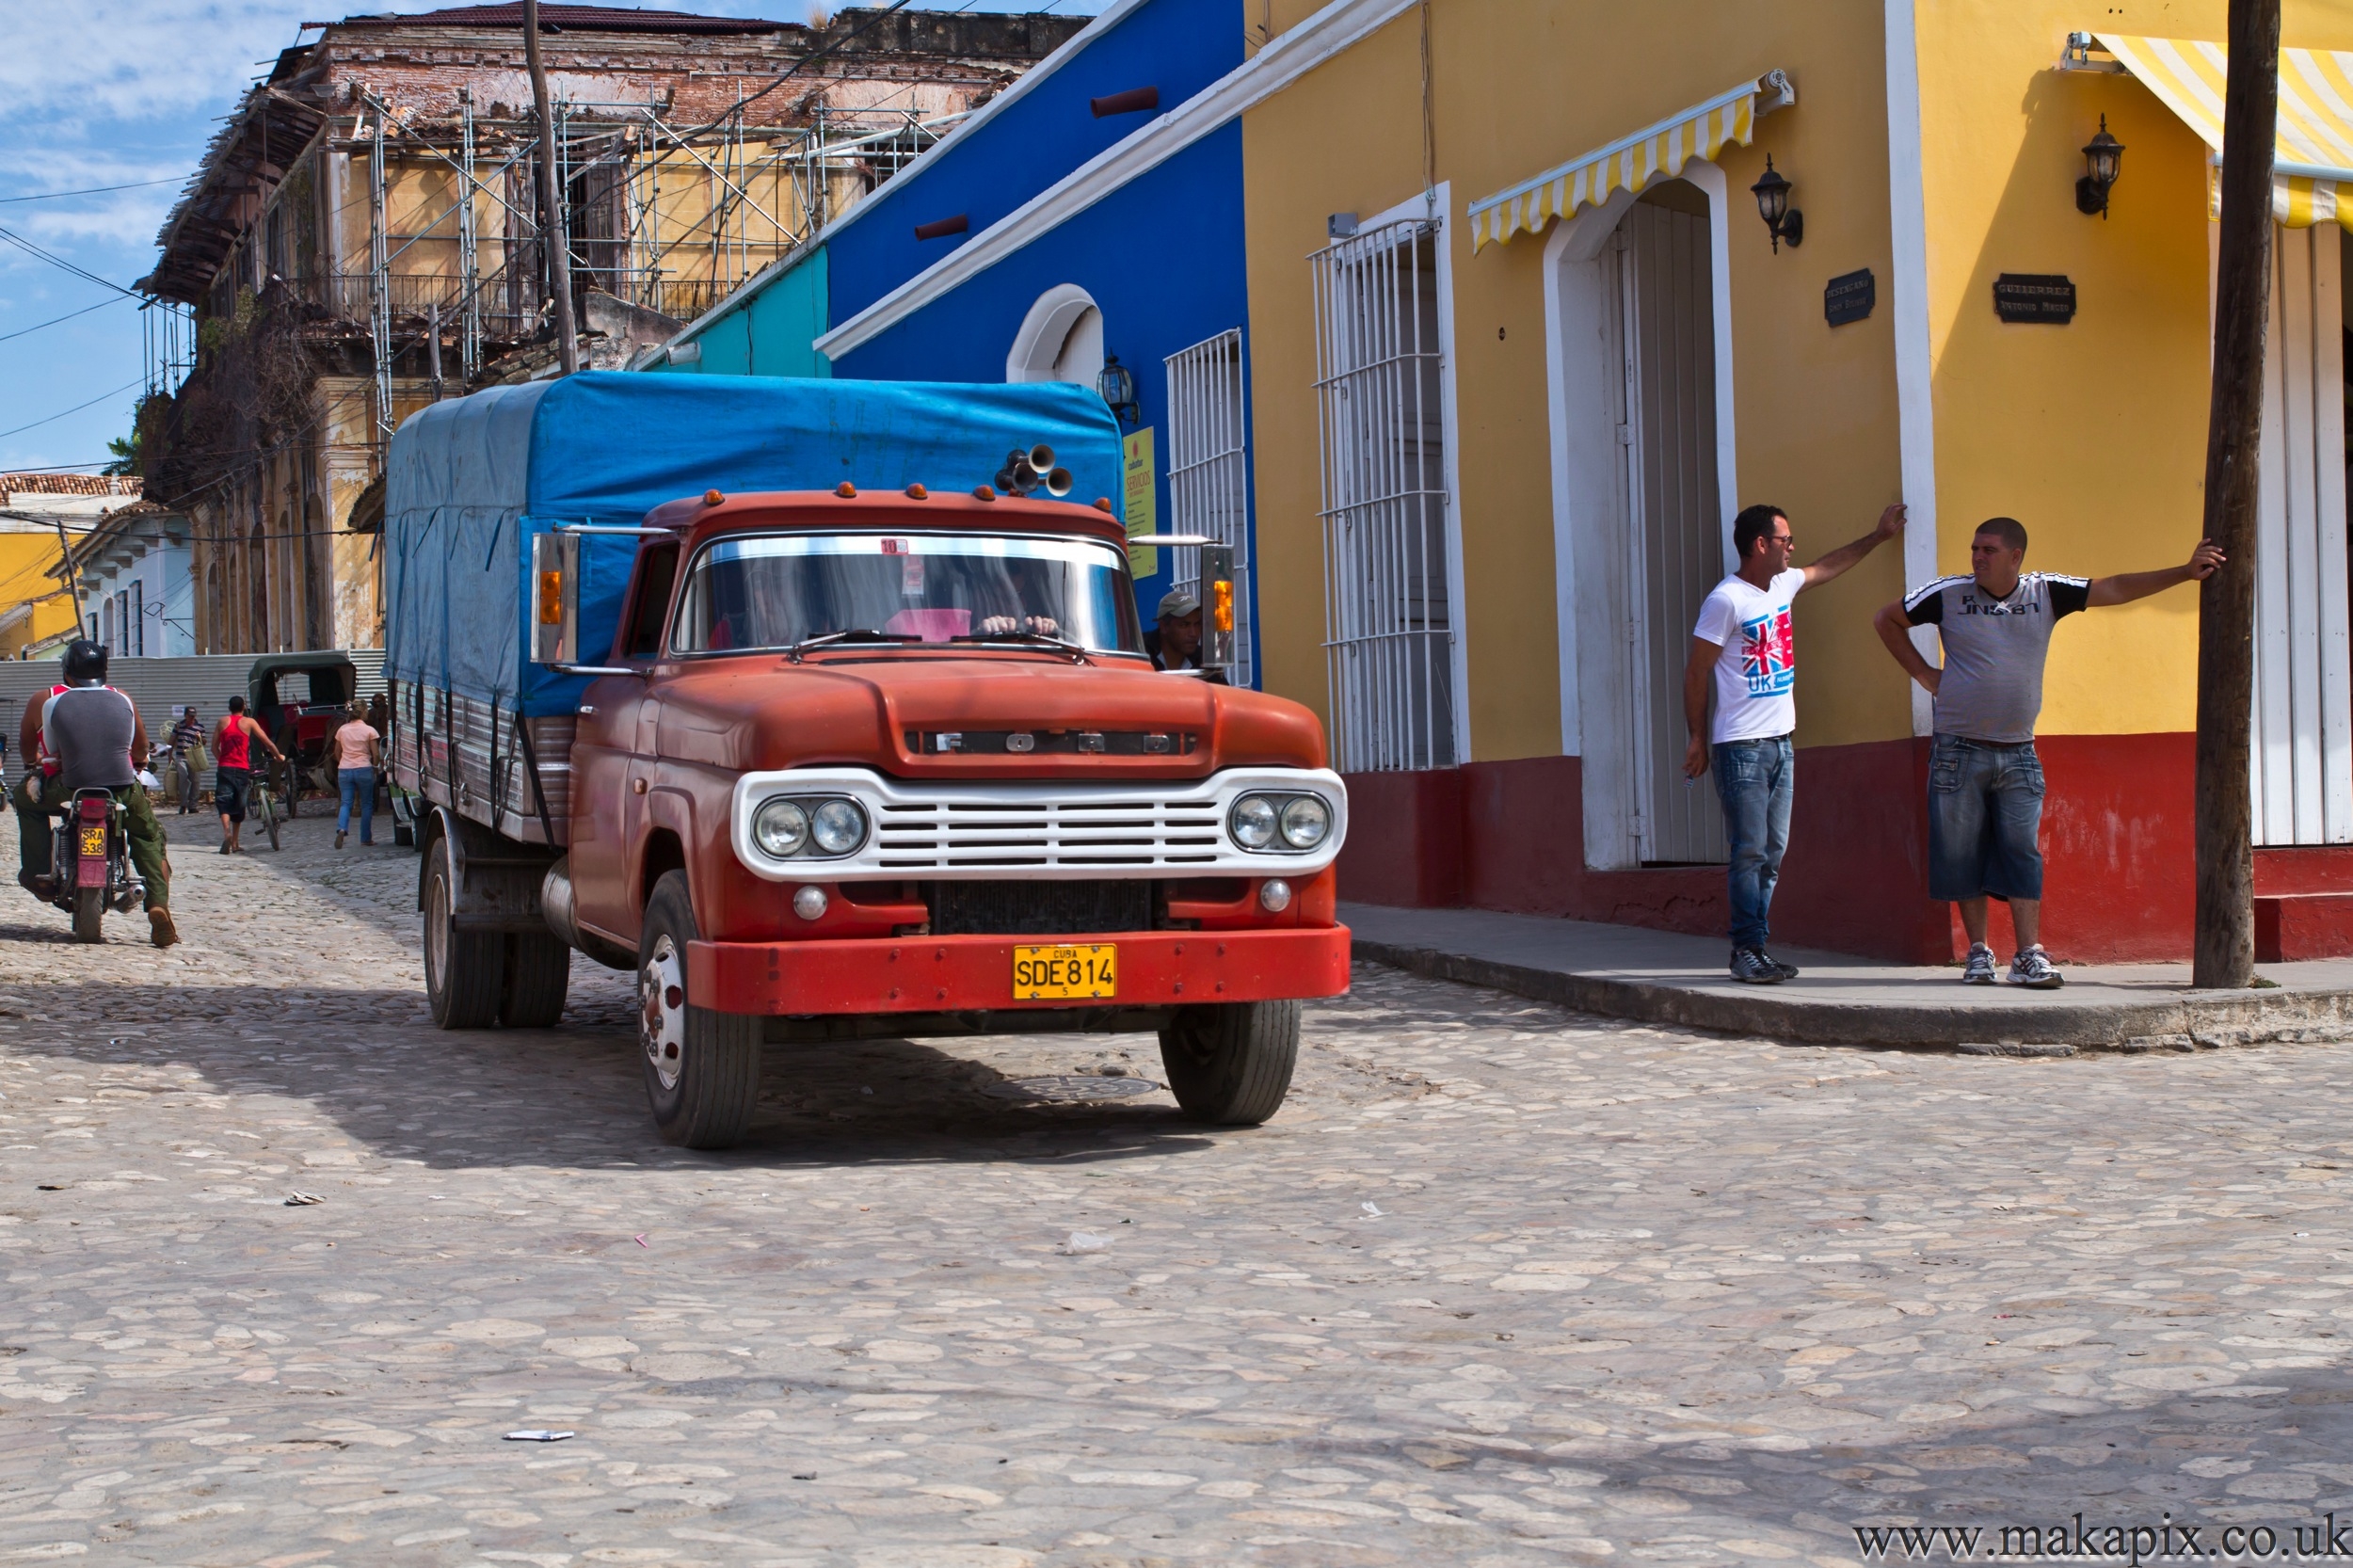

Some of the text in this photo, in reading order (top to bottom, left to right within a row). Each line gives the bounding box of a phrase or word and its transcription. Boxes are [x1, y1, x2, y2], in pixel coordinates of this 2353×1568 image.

[1998, 284, 2071, 296] GUTIERREZ
[1749, 675, 1771, 693] UK
[936, 732, 1170, 753] FORD
[83, 829, 104, 841] SRA
[82, 842, 104, 854] 538
[1053, 950, 1078, 958] CUBA
[1016, 959, 1112, 986] SDE814
[1063, 987, 1068, 996] 5
